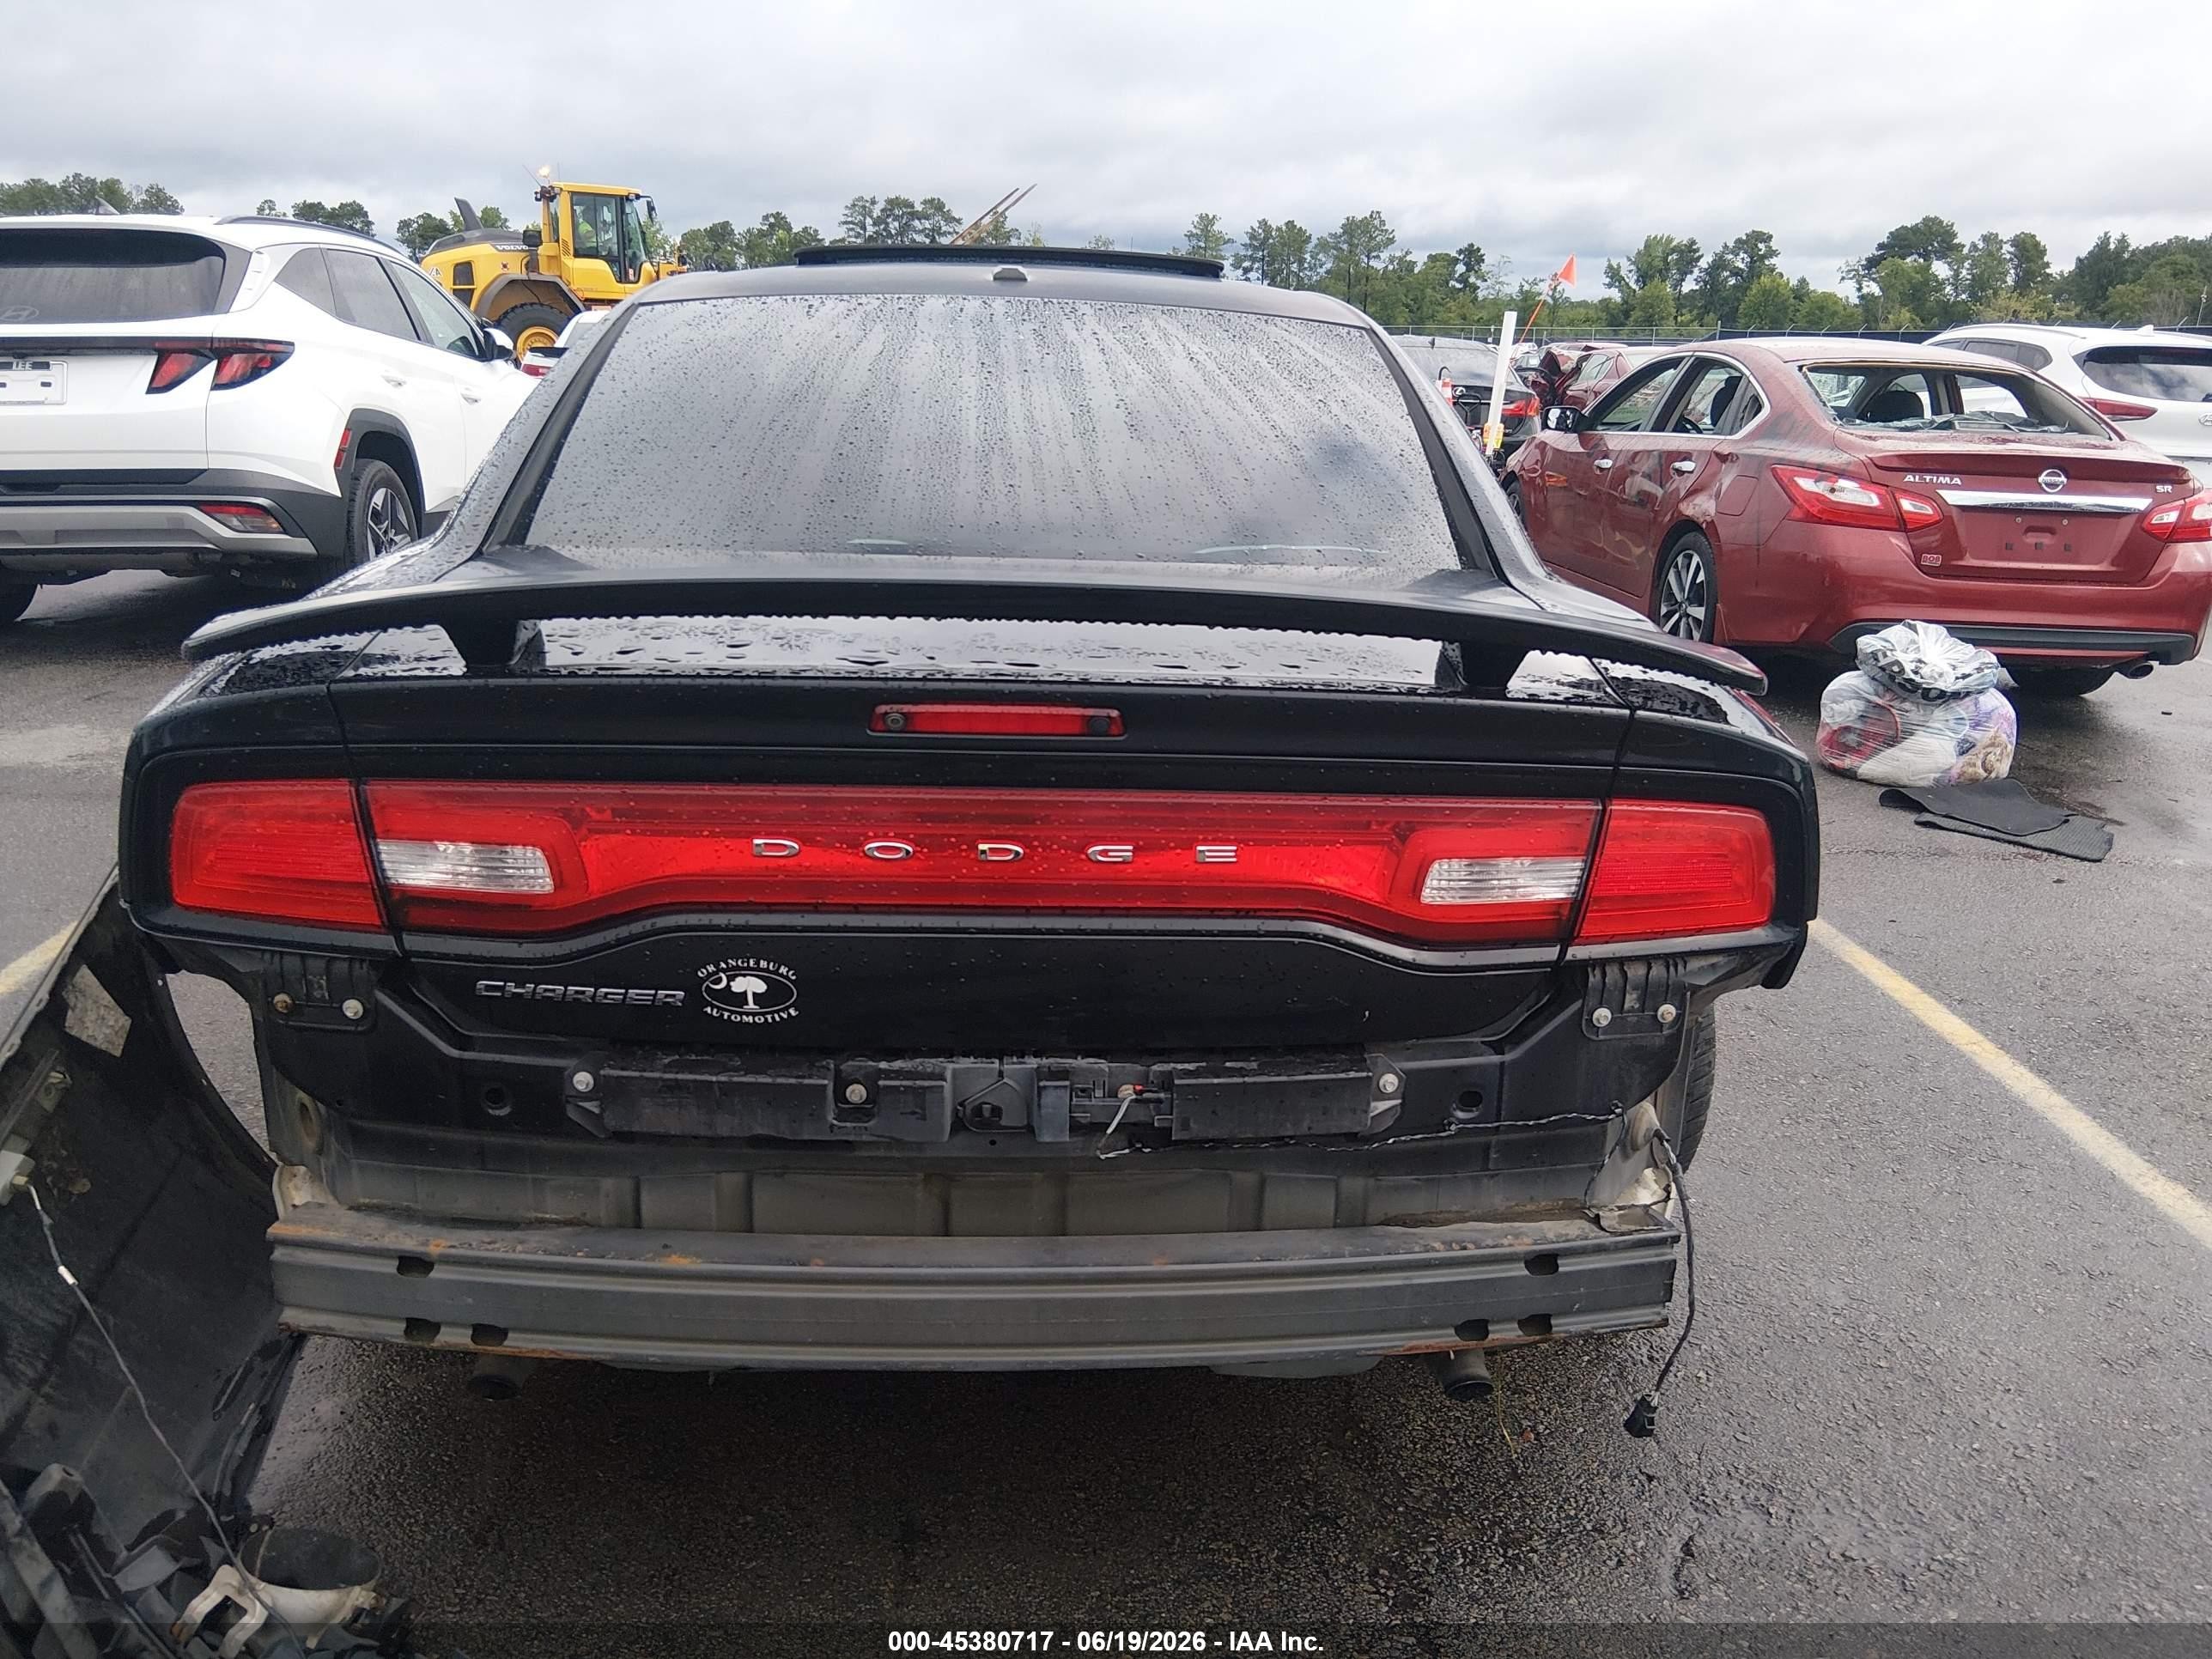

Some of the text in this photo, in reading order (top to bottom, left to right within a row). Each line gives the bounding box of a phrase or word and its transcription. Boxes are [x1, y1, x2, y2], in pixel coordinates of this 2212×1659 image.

[12, 362, 33, 371] LEE
[1903, 474, 1962, 485] ALTIMA
[752, 838, 1237, 862] DODGE
[696, 957, 797, 980] ORANGEBURG
[475, 980, 685, 1007] CHARGER
[703, 1006, 799, 1024] AUTOMOTIVE
